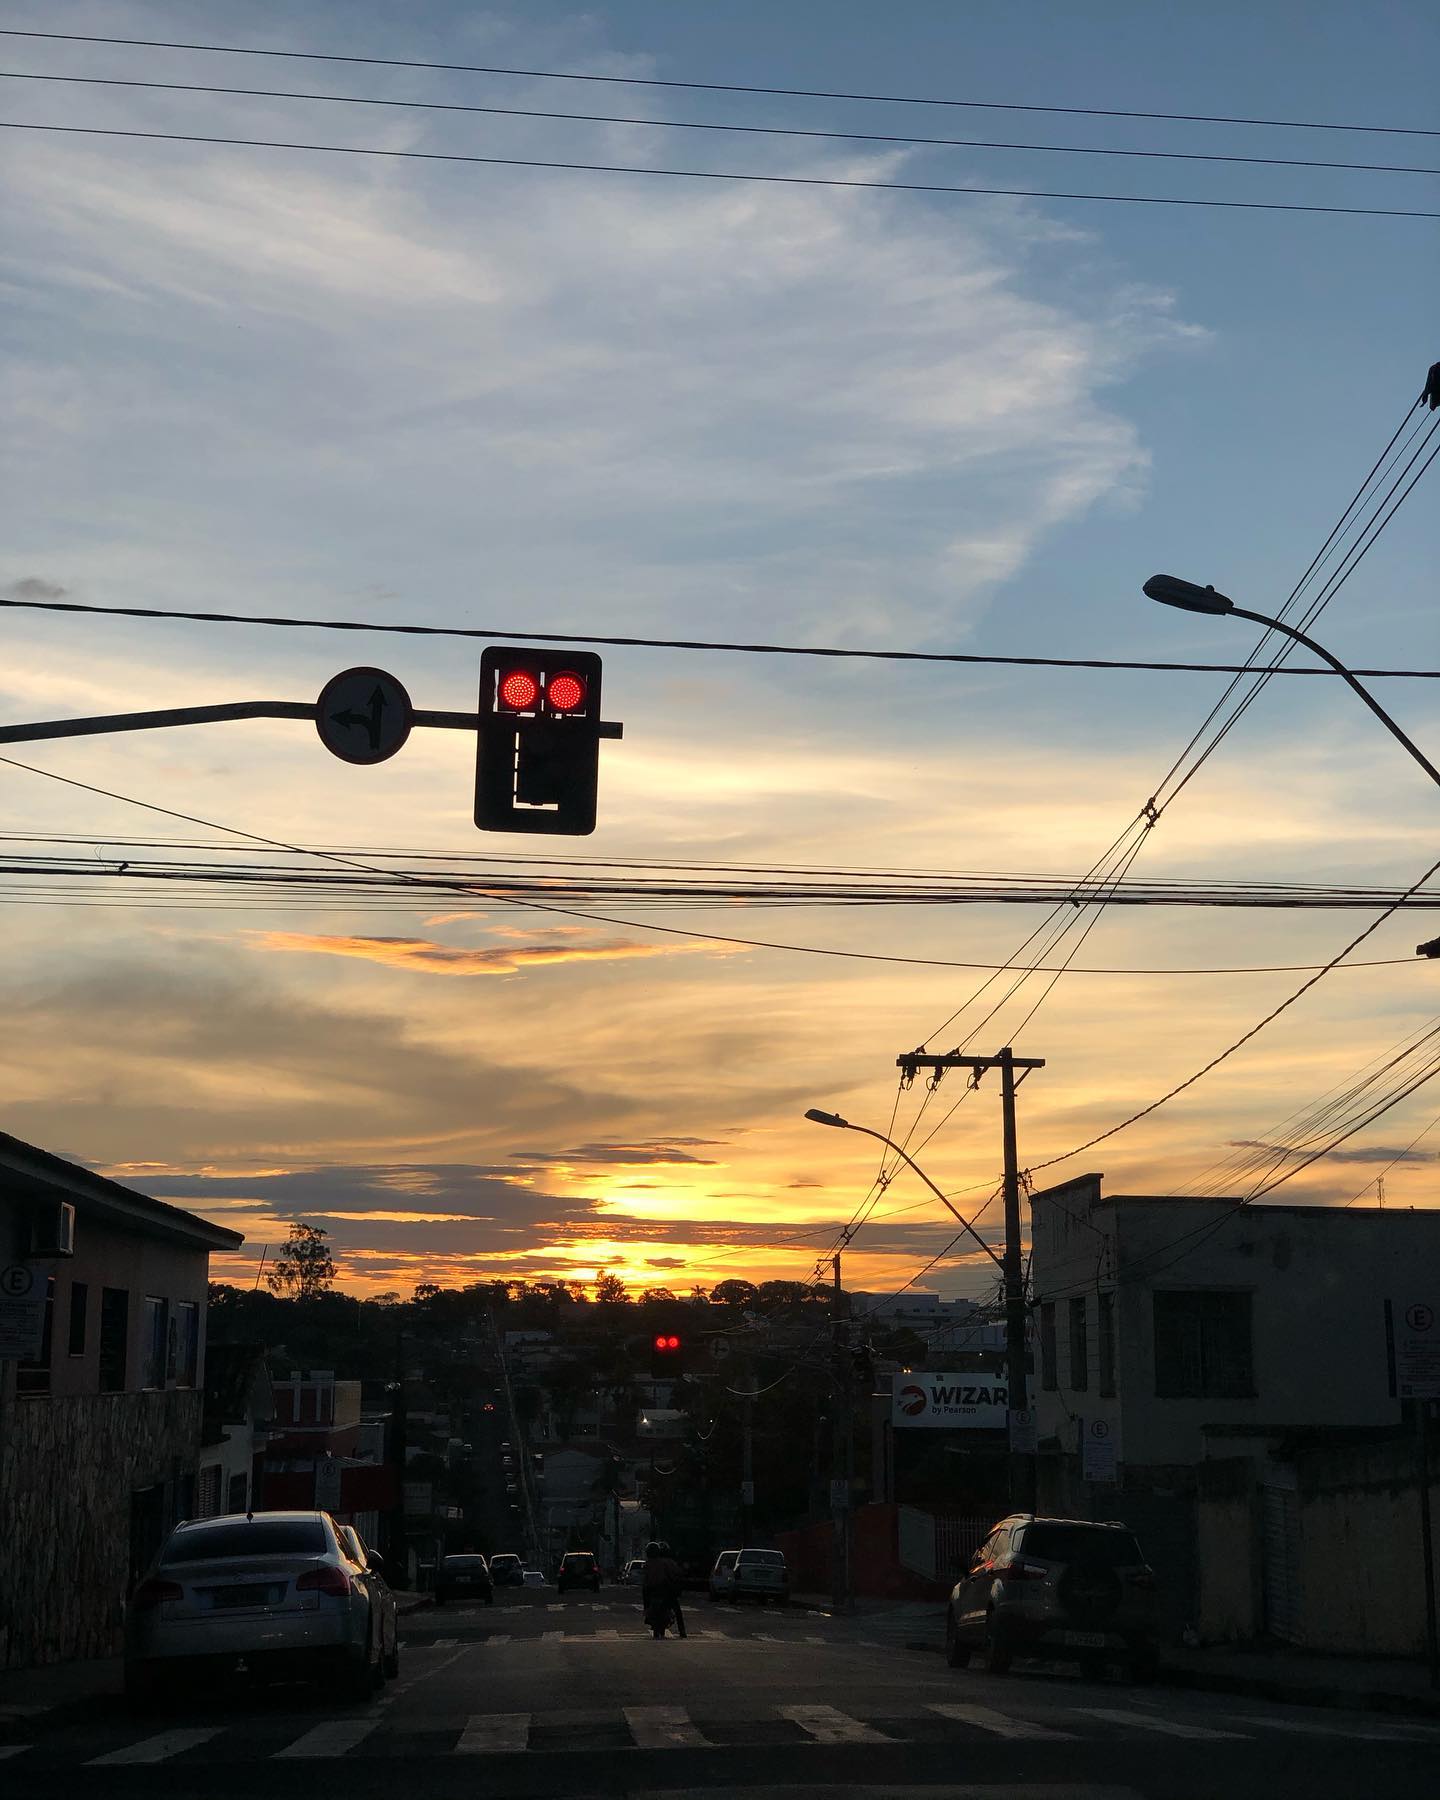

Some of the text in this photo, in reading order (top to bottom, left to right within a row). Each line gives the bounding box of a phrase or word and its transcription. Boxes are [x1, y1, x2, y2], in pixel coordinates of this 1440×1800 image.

[11, 1271, 24, 1290] E
[1414, 1309, 1425, 1326] E
[930, 1386, 1008, 1406] WIZAR
[931, 1406, 977, 1416] by Pearson
